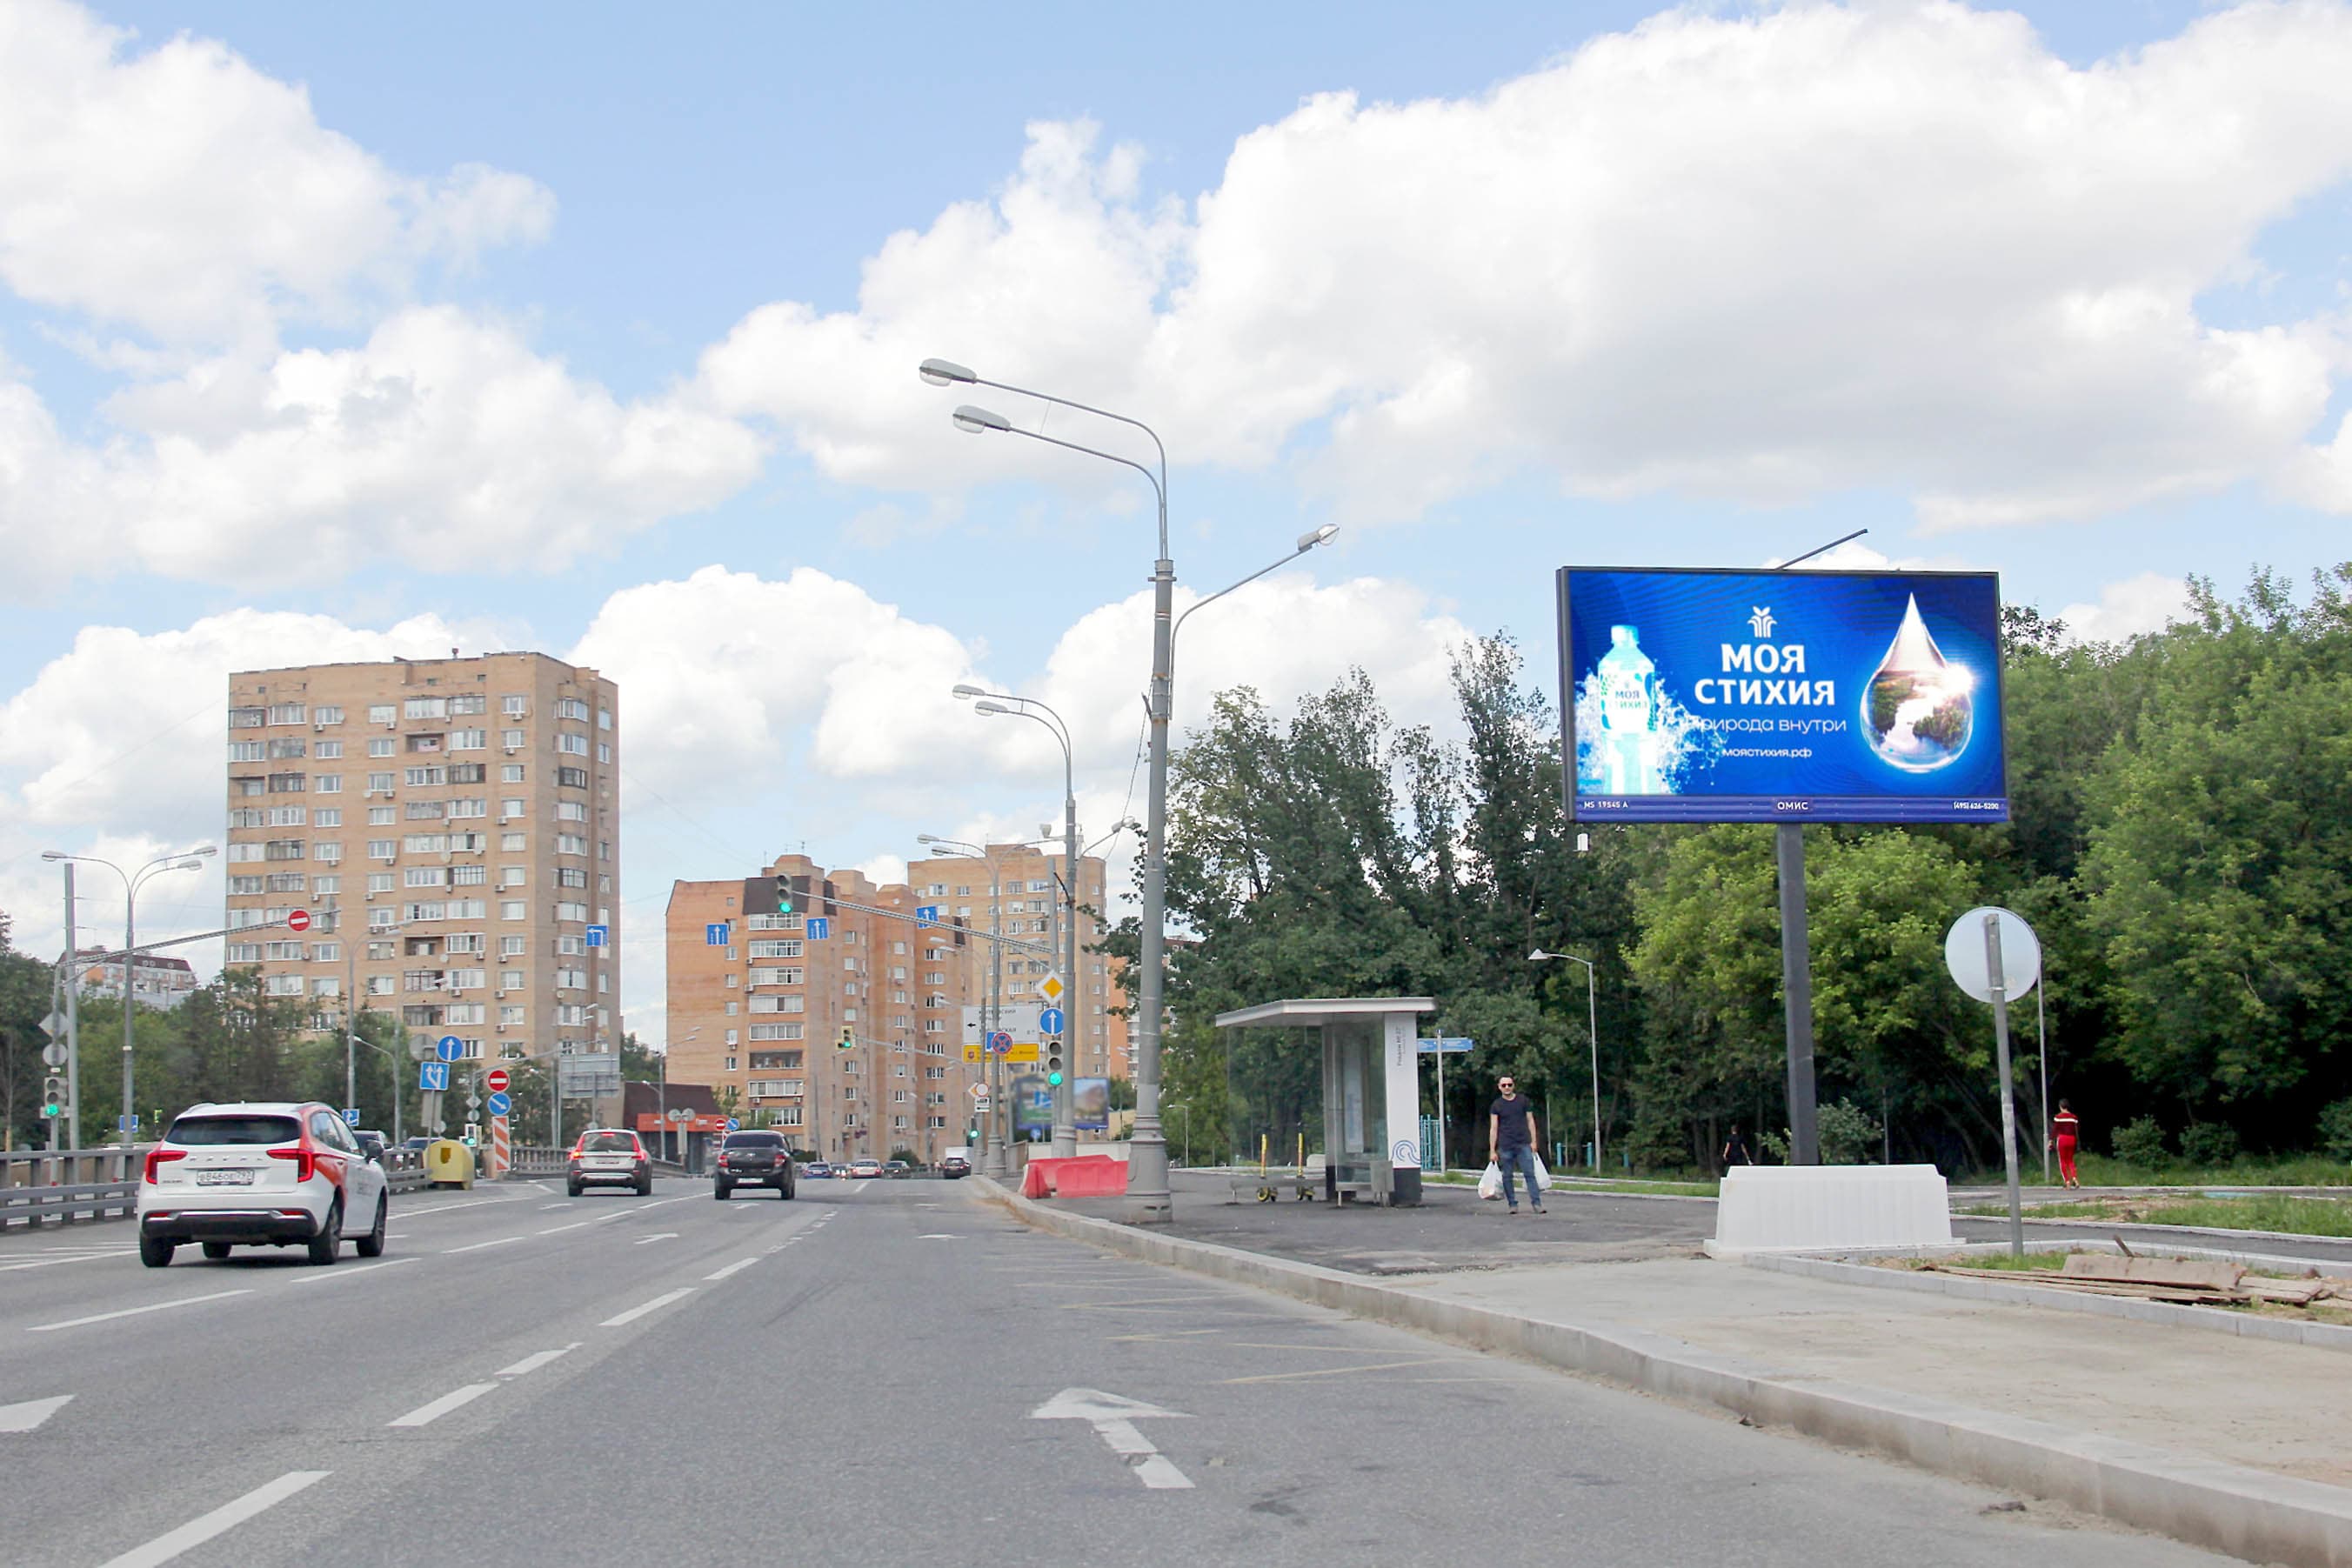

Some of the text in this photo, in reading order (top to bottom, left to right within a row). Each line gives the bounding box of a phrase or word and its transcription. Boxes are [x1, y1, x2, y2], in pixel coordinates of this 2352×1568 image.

[1721, 644, 1806, 674] МОЯ
[1614, 690, 1640, 699] МОЯ
[1694, 678, 1835, 706] СТИХИЯ
[1687, 717, 1847, 734] рирода внутри
[1722, 747, 1813, 758] моястихия.рф
[1777, 801, 1809, 810] ОМИС
